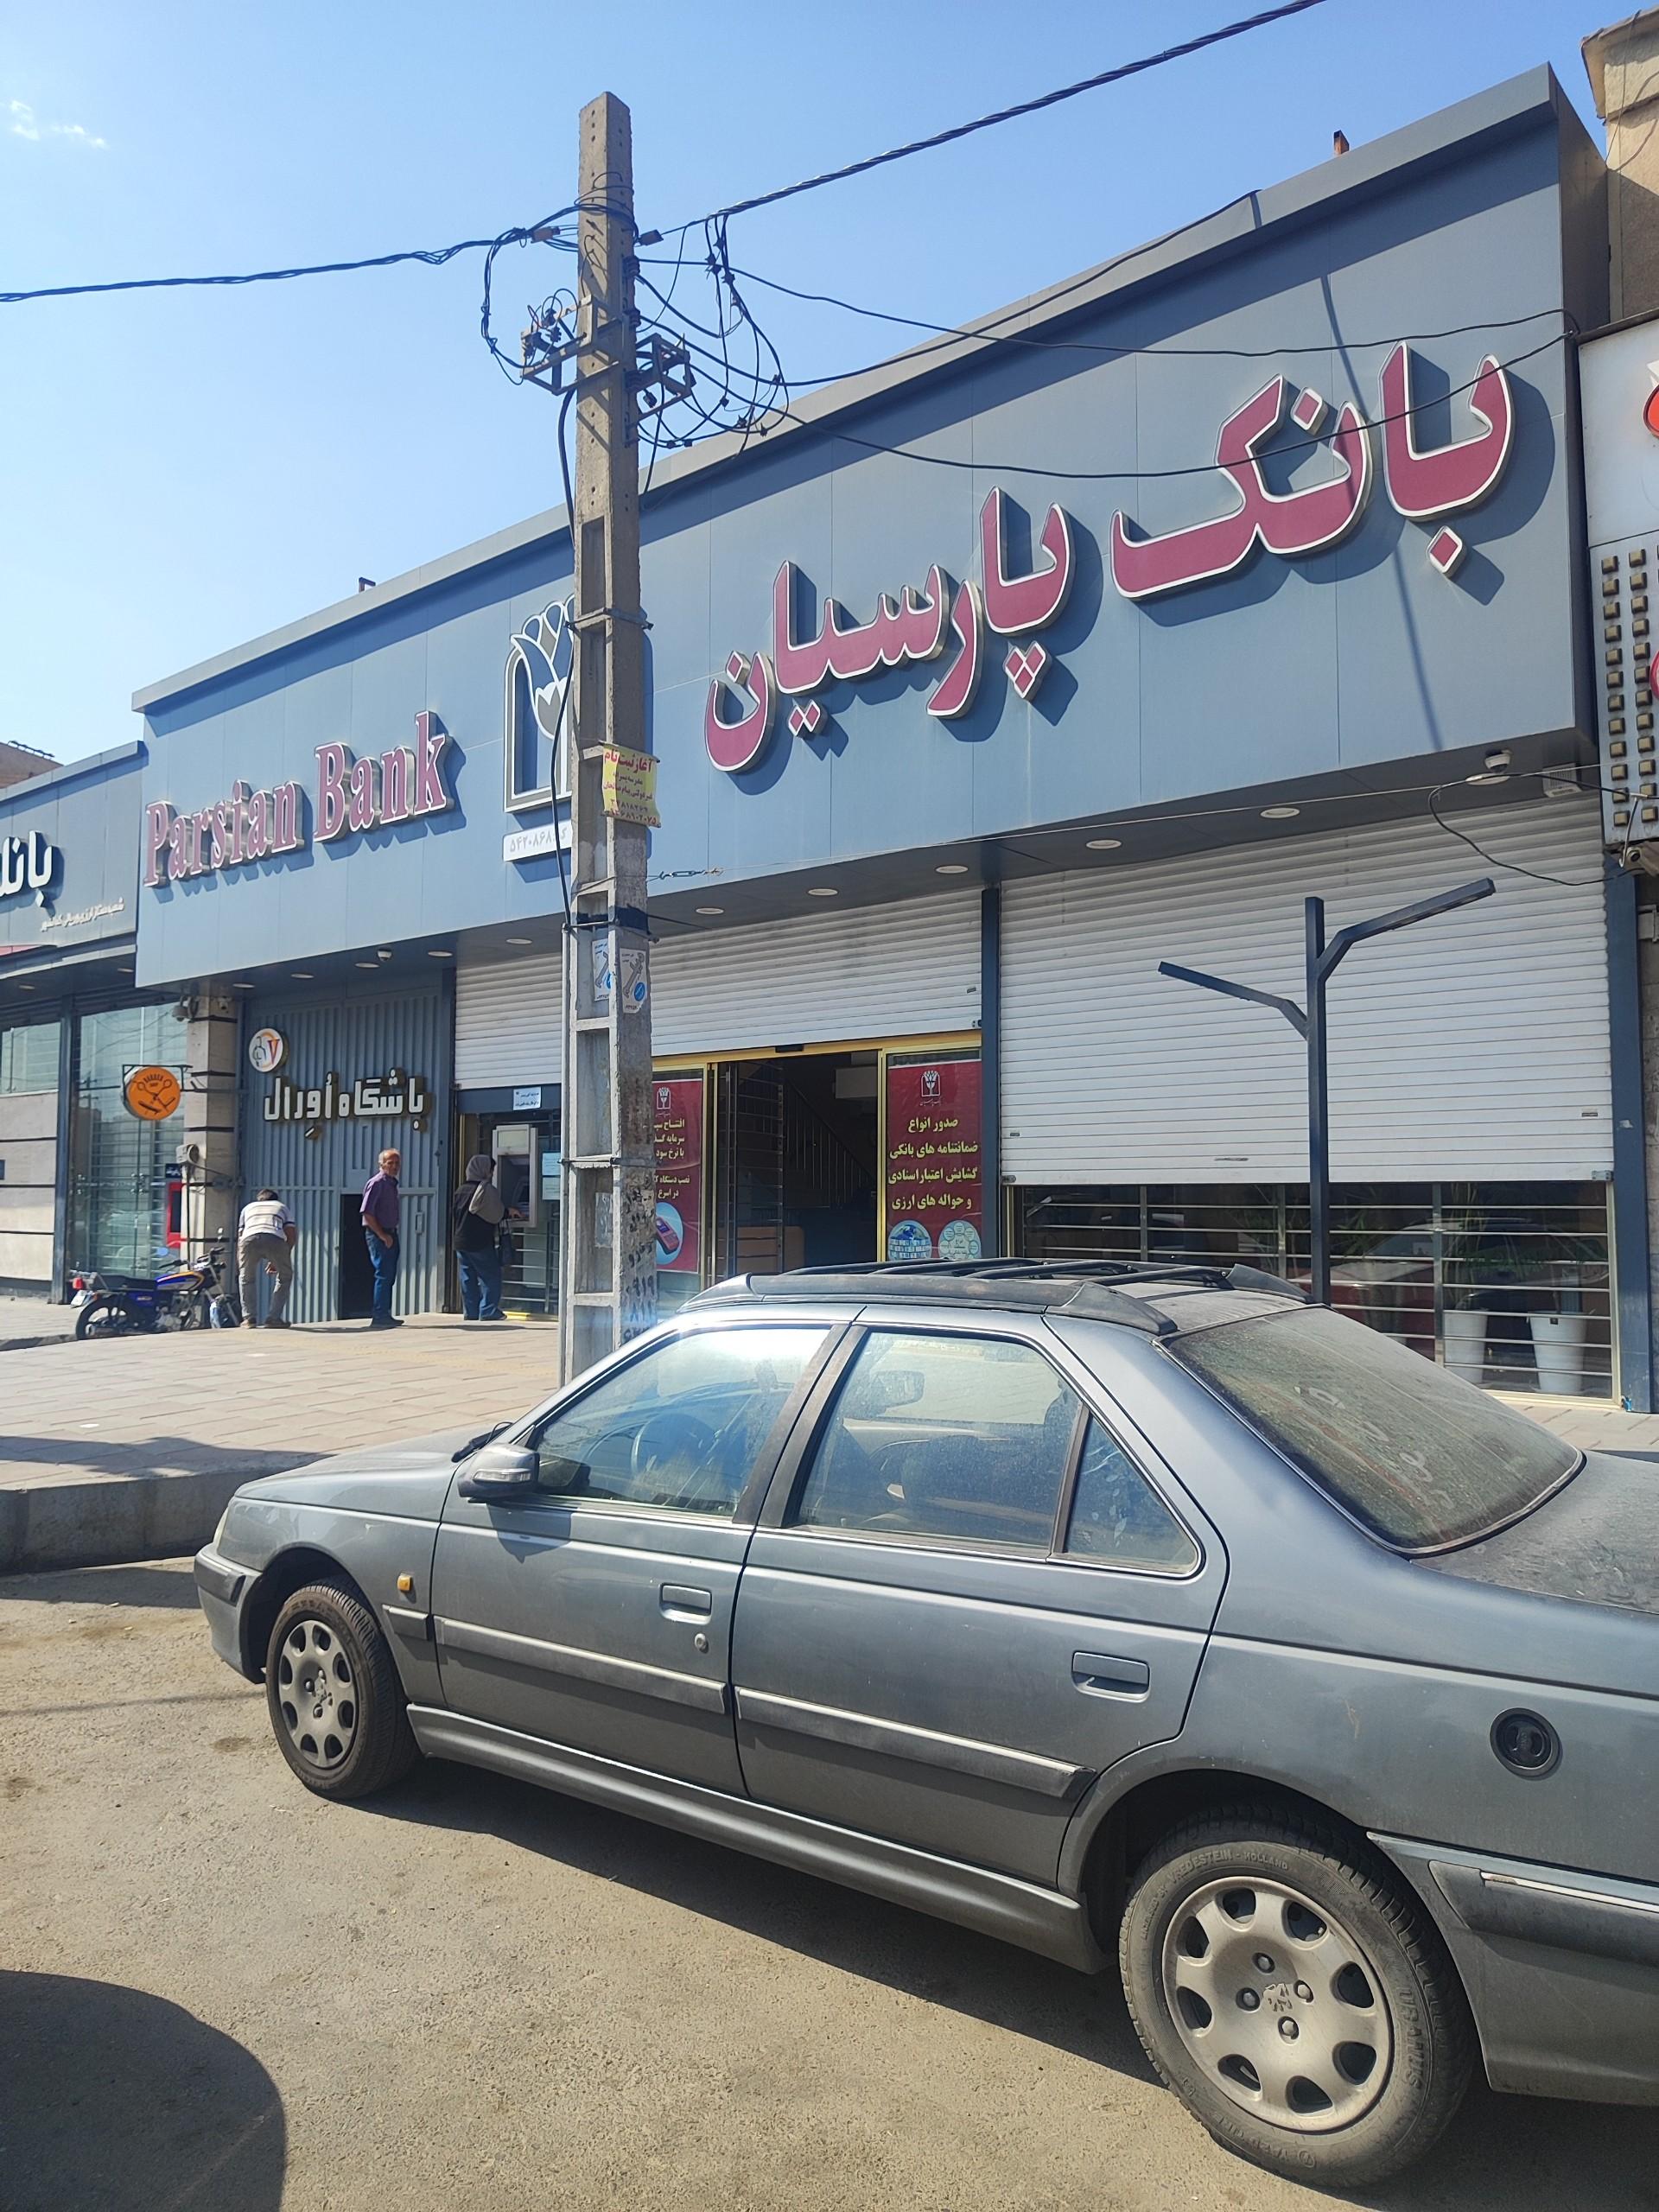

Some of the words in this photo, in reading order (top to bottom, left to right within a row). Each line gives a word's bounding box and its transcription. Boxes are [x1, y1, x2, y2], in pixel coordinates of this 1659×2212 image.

[1109, 340, 1514, 599] بانک
[705, 486, 1073, 772] پارسیان
[143, 779, 300, 887] Parsian
[313, 710, 448, 844] Bank
[338, 1067, 424, 1130] باشگاه
[907, 1116, 931, 1133] انواع
[933, 1118, 959, 1132] صدور
[655, 1149, 668, 1160] سود
[889, 1142, 915, 1160] بانکی
[916, 1141, 935, 1159] های
[888, 1167, 918, 1185] اسنادی
[918, 1167, 944, 1184] اعتبار
[945, 1166, 978, 1183] گشایش
[658, 1188, 671, 1199] اسرع
[892, 1193, 916, 1210] ارزی
[917, 1193, 936, 1210] های
[938, 1193, 964, 1210] حواله
[966, 1198, 972, 1210] و
[1166, 1849, 1233, 1885] VREDESTEIN
[1243, 1851, 1289, 1872] HOLLAND
